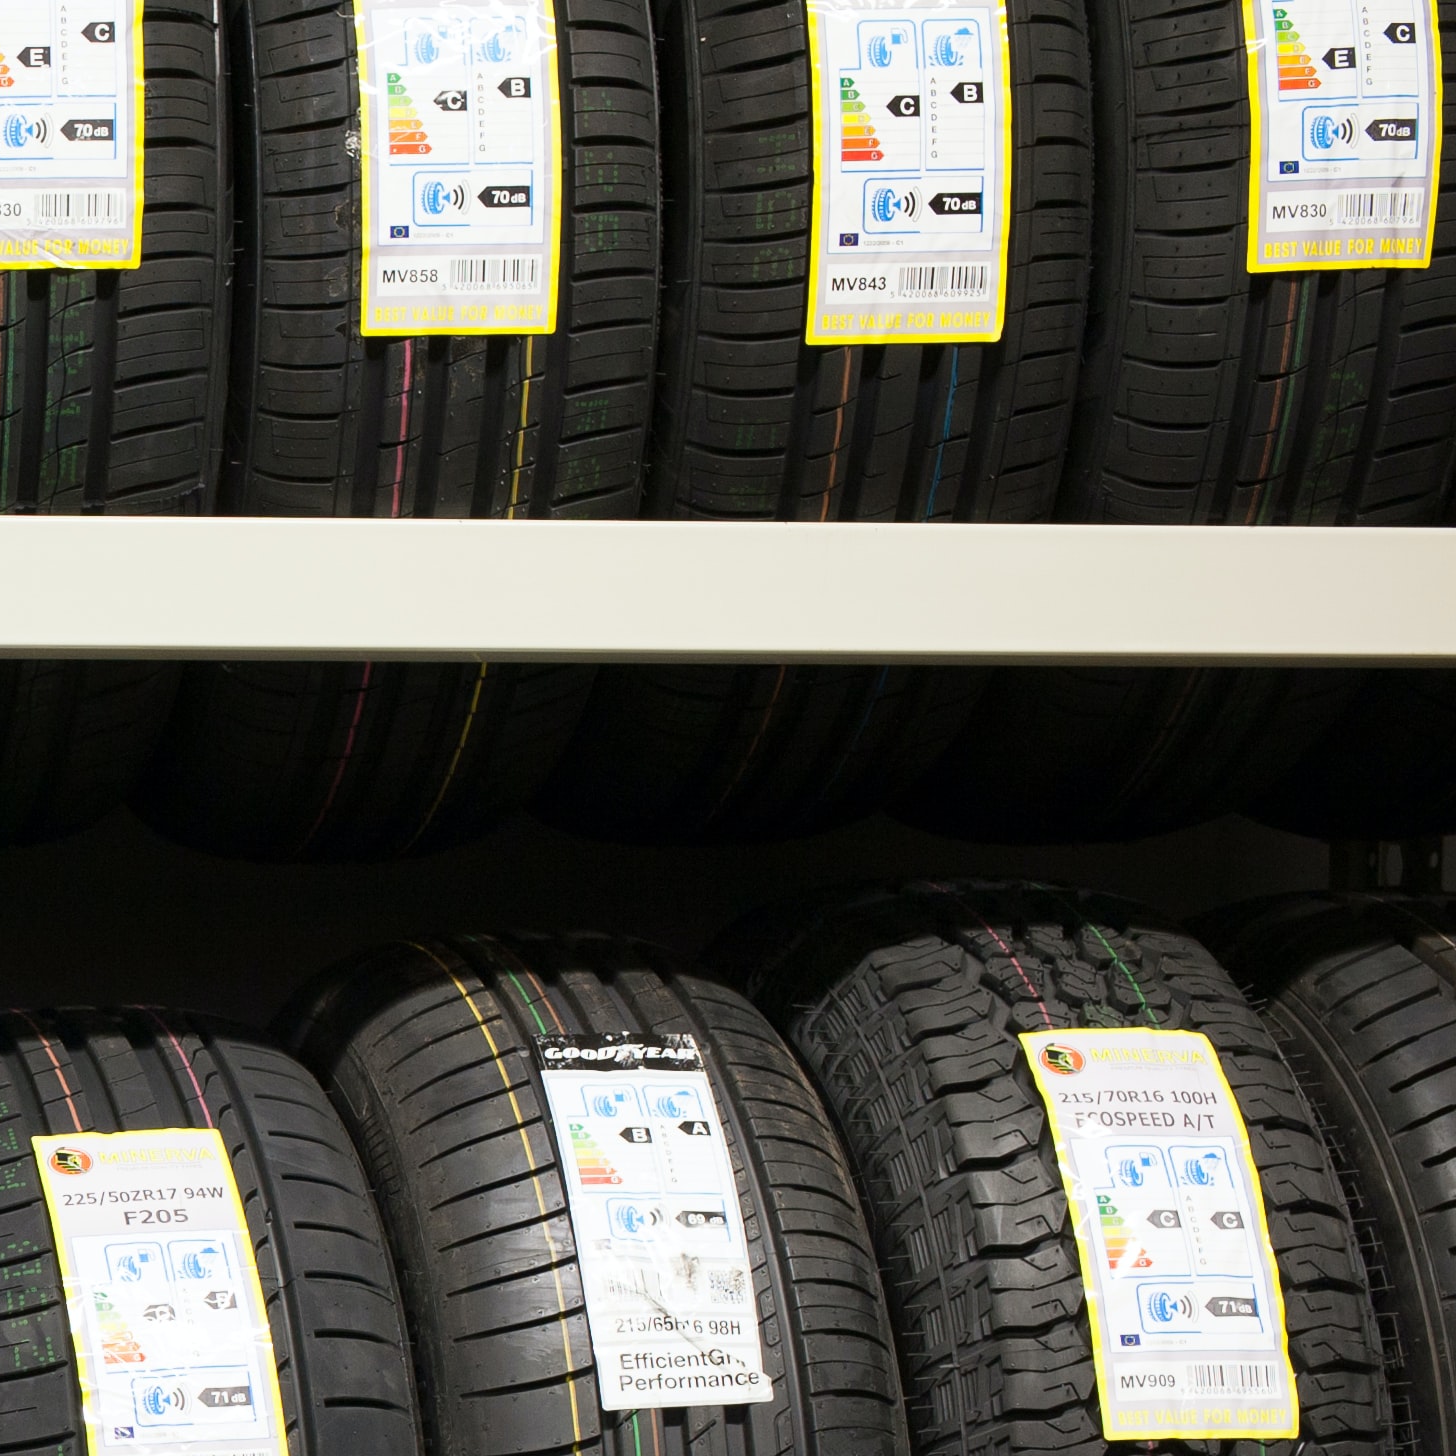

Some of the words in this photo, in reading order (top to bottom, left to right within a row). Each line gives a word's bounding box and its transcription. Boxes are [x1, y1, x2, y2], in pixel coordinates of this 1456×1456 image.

[94, 24, 110, 41] C
[1396, 25, 1410, 42] C
[30, 49, 44, 66] E
[1335, 50, 1349, 67] E
[510, 79, 526, 96] B
[963, 85, 978, 101] B
[447, 92, 462, 110] C
[899, 98, 915, 115] C
[1272, 204, 1327, 220] MV830
[382, 269, 438, 283] MV858
[831, 277, 887, 291] MV843
[1090, 1047, 1208, 1065] MINERVA
[1058, 1090, 1164, 1105] 215/70R16
[1170, 1090, 1217, 1105] 100H
[692, 1122, 708, 1135] A
[1183, 1113, 1215, 1132] A/T
[632, 1129, 648, 1142] B
[98, 1146, 215, 1165] MINERVA
[62, 1187, 177, 1207] 225/50ZR17
[184, 1186, 224, 1200] 94W
[123, 1208, 188, 1225] F205
[1159, 1211, 1177, 1228] C
[1222, 1213, 1238, 1228] C
[708, 1320, 741, 1335] 98H
[619, 1371, 760, 1392] Performance
[1120, 1374, 1176, 1389] MV909
